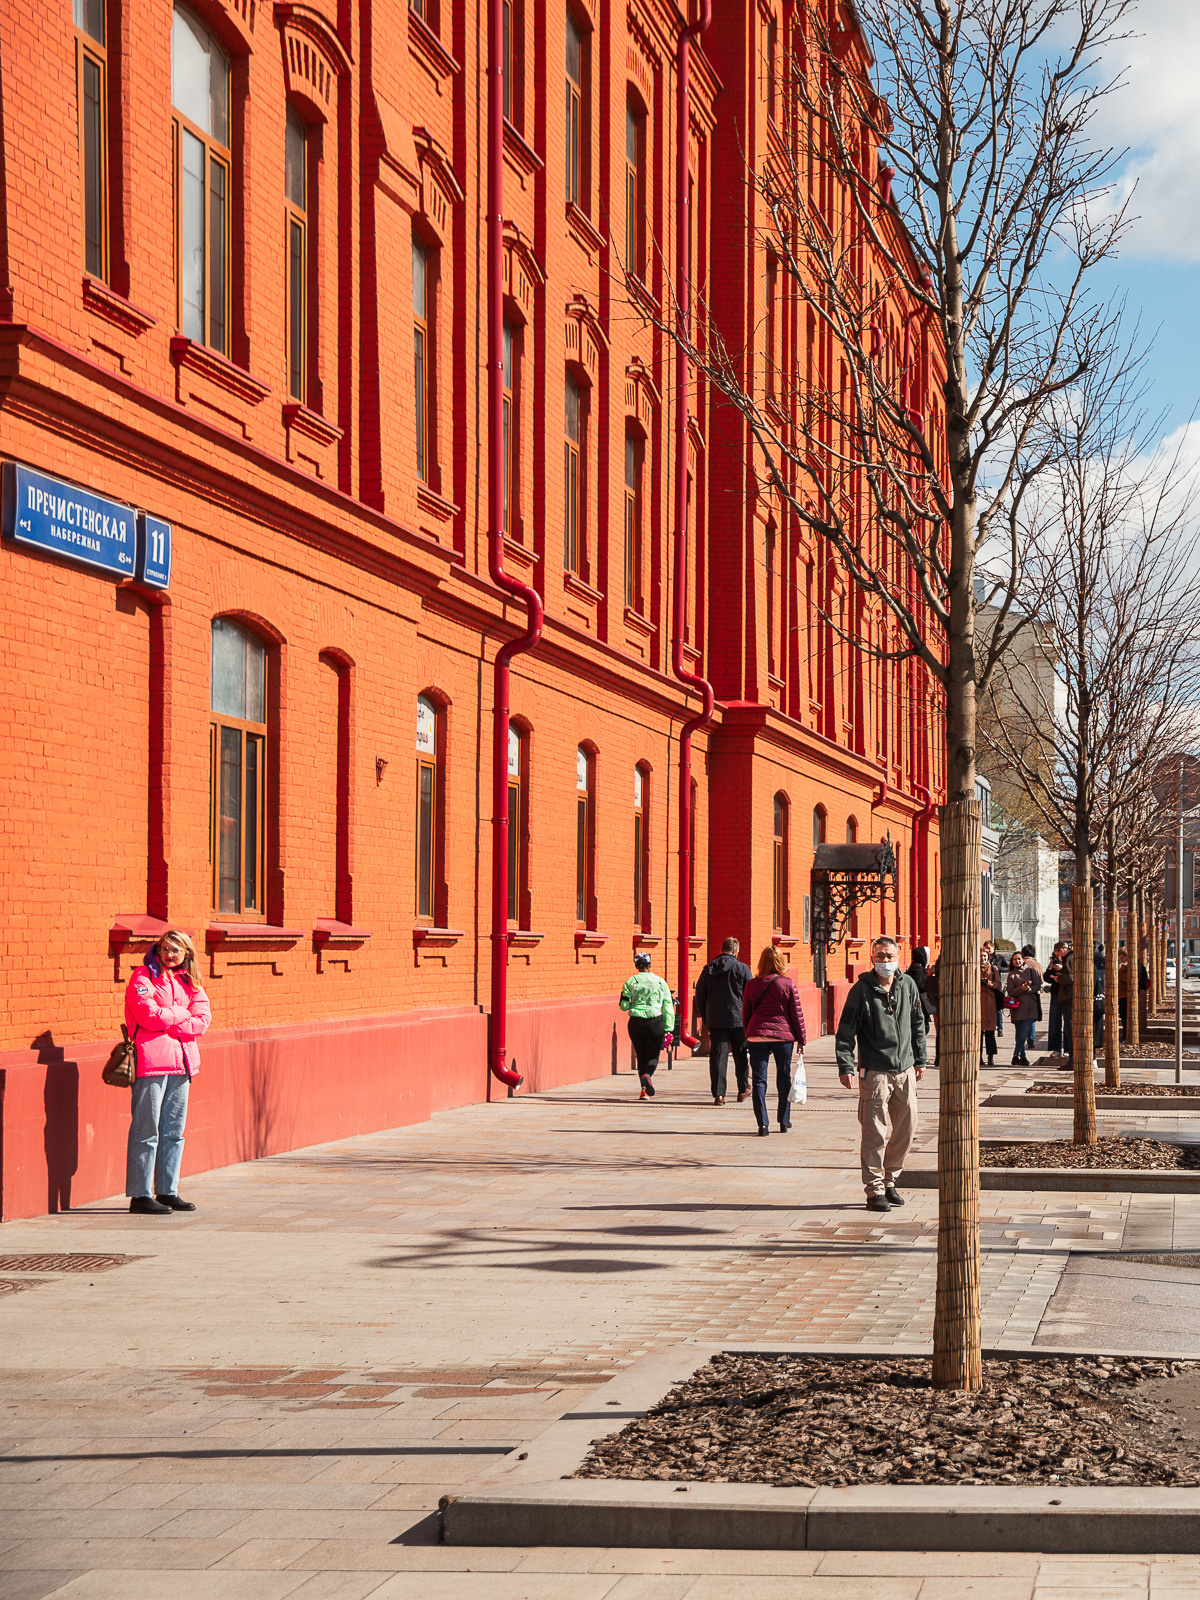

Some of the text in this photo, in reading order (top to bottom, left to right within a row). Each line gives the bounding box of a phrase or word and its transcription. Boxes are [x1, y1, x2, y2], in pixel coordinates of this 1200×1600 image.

[27, 485, 127, 543] ПРЕЧИСТЕНСКАЯ
[50, 523, 101, 552] НАБЕРЕЖНАЯ
[152, 530, 165, 565] 11
